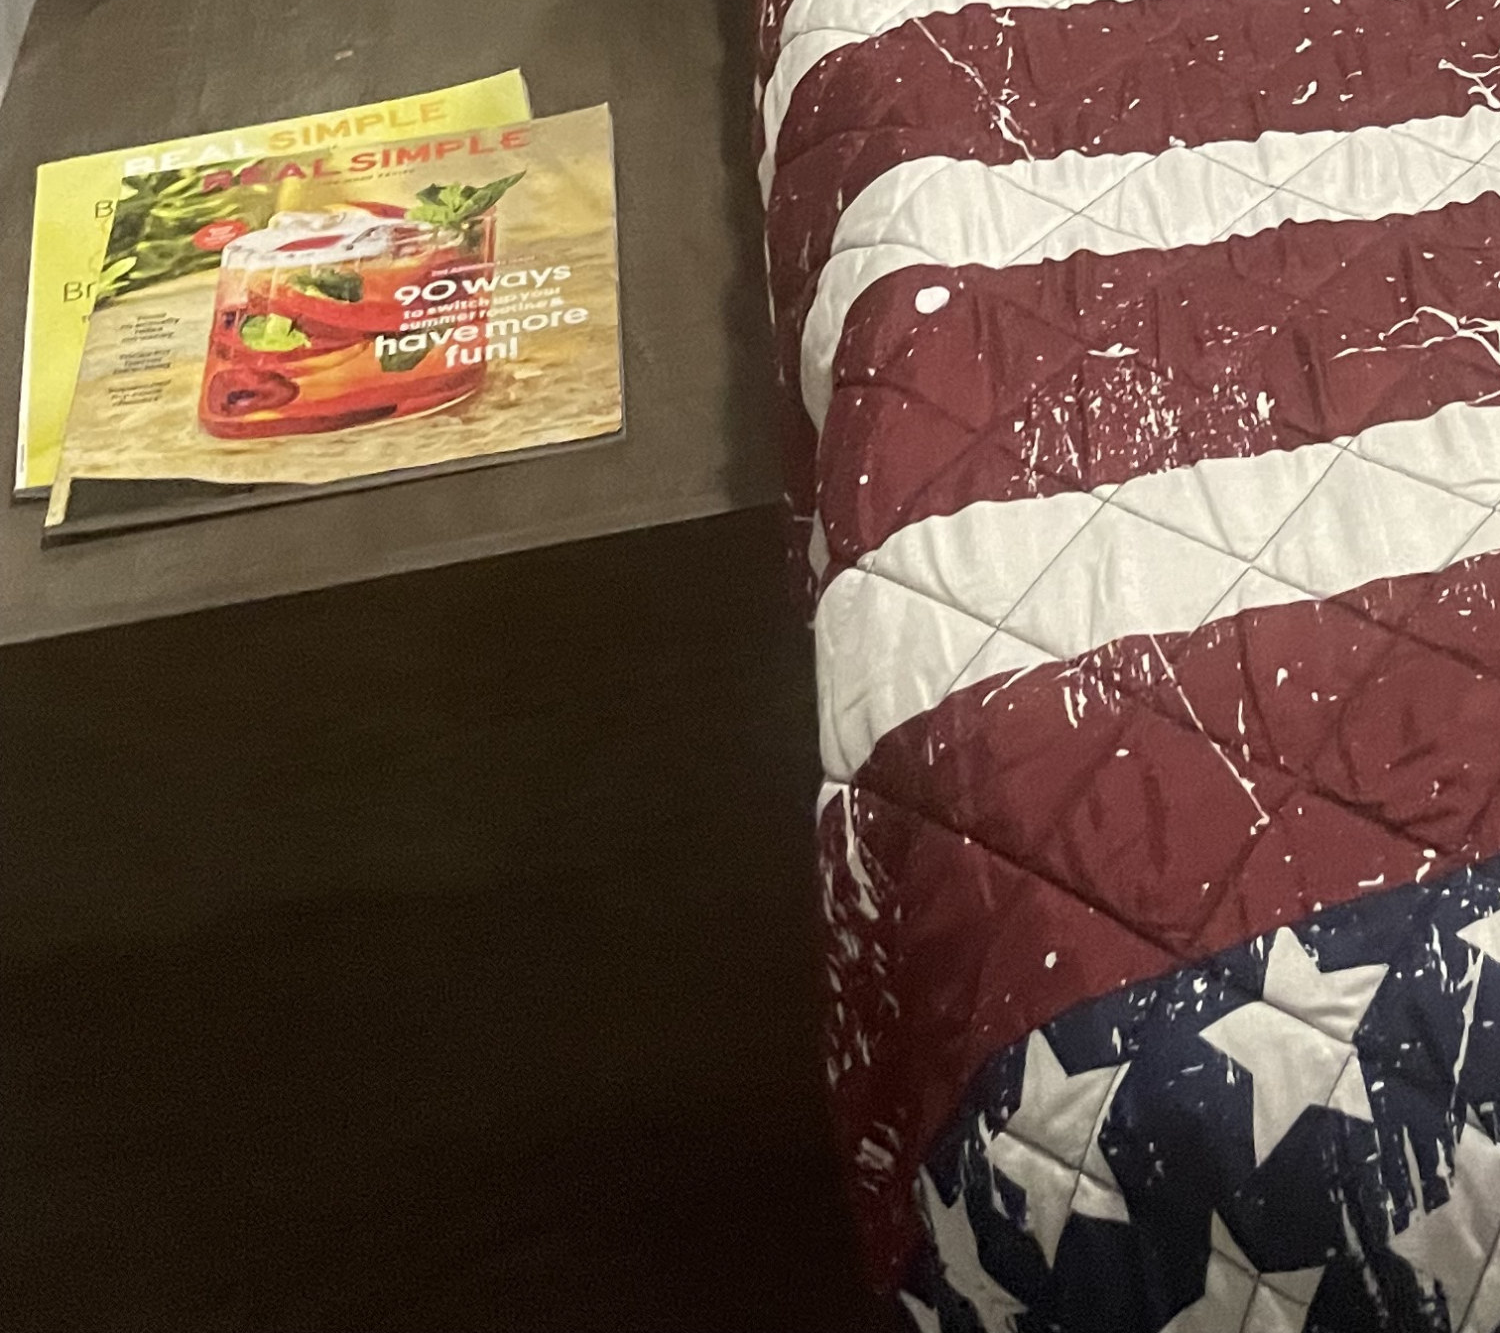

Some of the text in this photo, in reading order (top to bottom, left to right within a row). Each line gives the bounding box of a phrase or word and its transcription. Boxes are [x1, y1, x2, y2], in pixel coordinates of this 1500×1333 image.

[268, 100, 448, 153] SIMPLE
[202, 158, 341, 194] REAL
[349, 128, 532, 173] SIMPLE
[394, 279, 457, 306] 90
[462, 265, 571, 294] ways
[426, 296, 490, 316] switch
[375, 308, 589, 358] have more
[400, 310, 477, 332] summer
